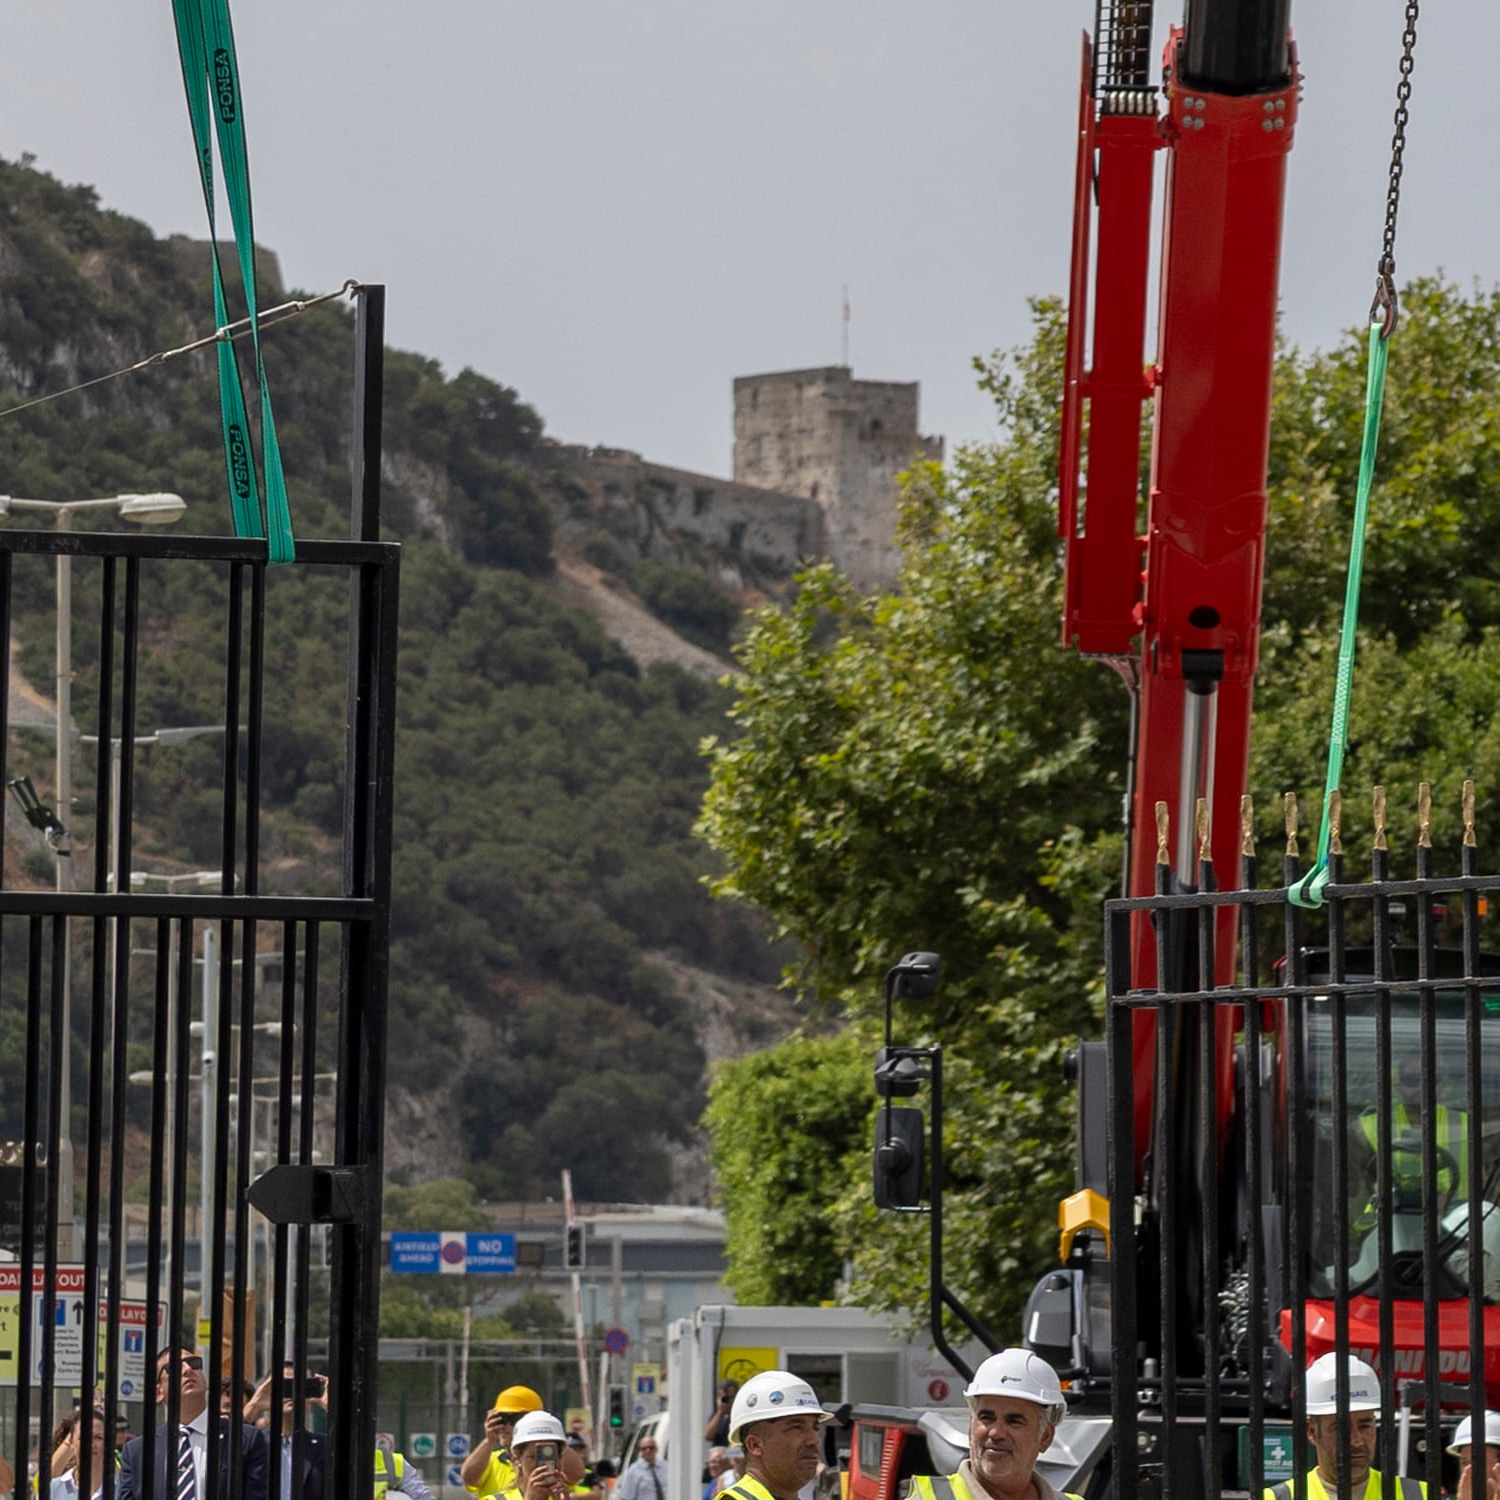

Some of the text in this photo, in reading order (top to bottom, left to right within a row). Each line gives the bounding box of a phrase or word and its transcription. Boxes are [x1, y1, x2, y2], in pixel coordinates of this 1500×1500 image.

[216, 52, 234, 119] PONSA
[231, 429, 249, 494] PONSA
[399, 1253, 435, 1263] AHEAD
[477, 1240, 503, 1254] NO
[1349, 1348, 1472, 1373] MNIOU
